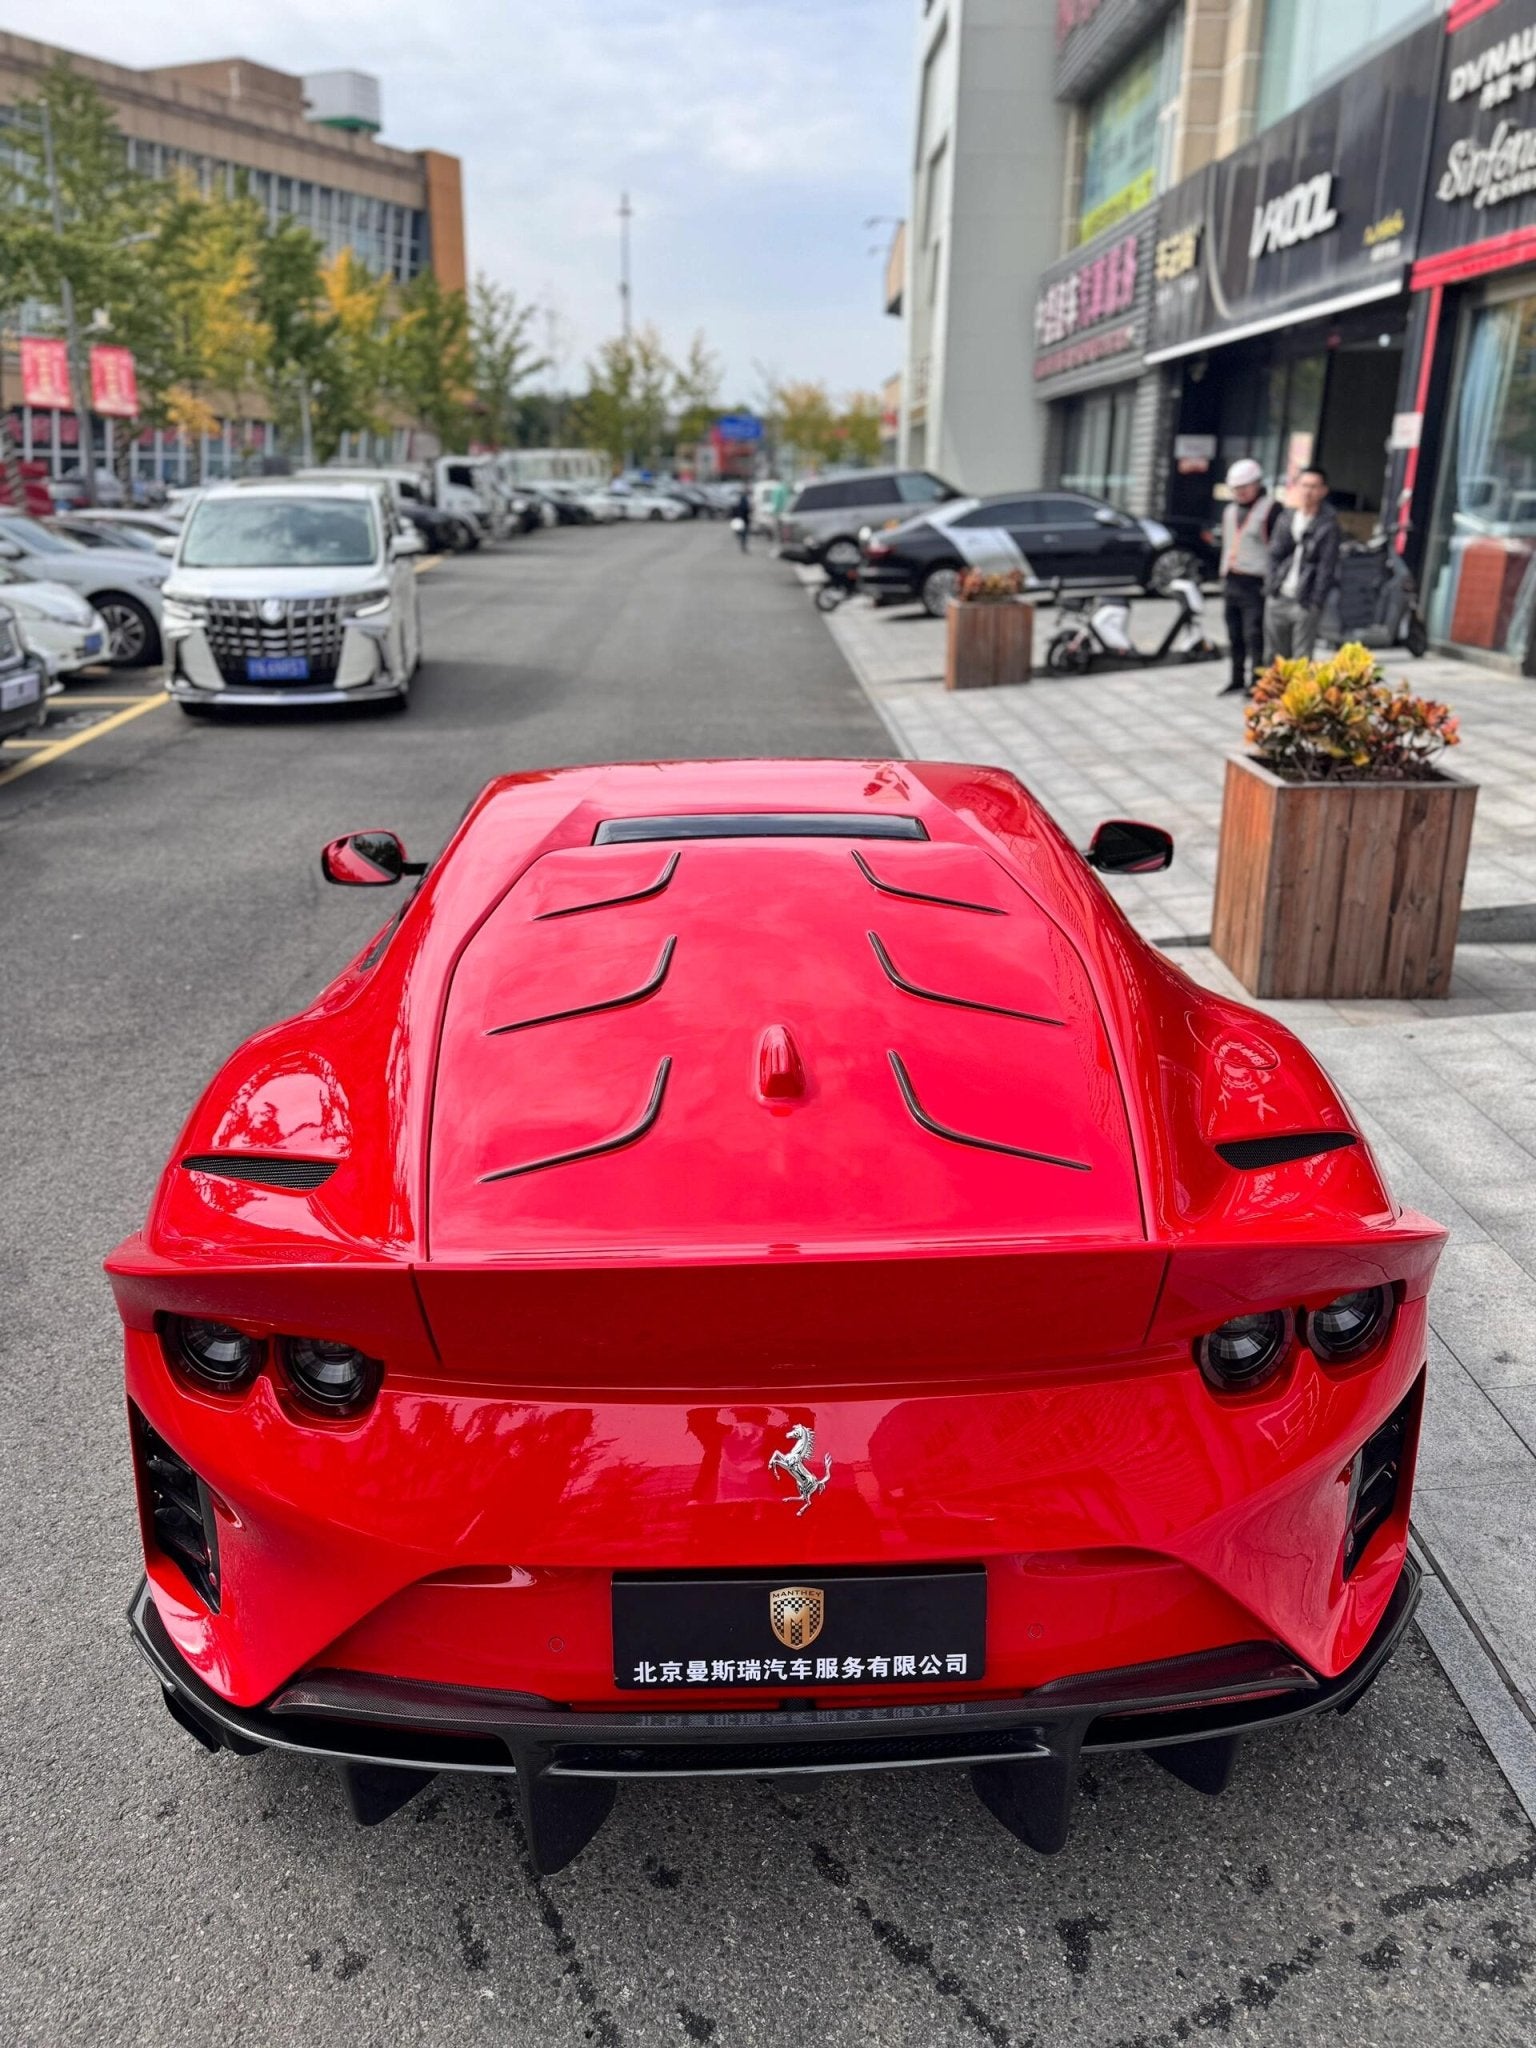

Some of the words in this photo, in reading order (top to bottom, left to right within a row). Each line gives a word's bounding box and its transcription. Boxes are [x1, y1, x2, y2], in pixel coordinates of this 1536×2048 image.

[772, 1589, 821, 1599] MANTHEY
[633, 1653, 968, 1683] 北京曼斯瑞汽车服务有限公司
